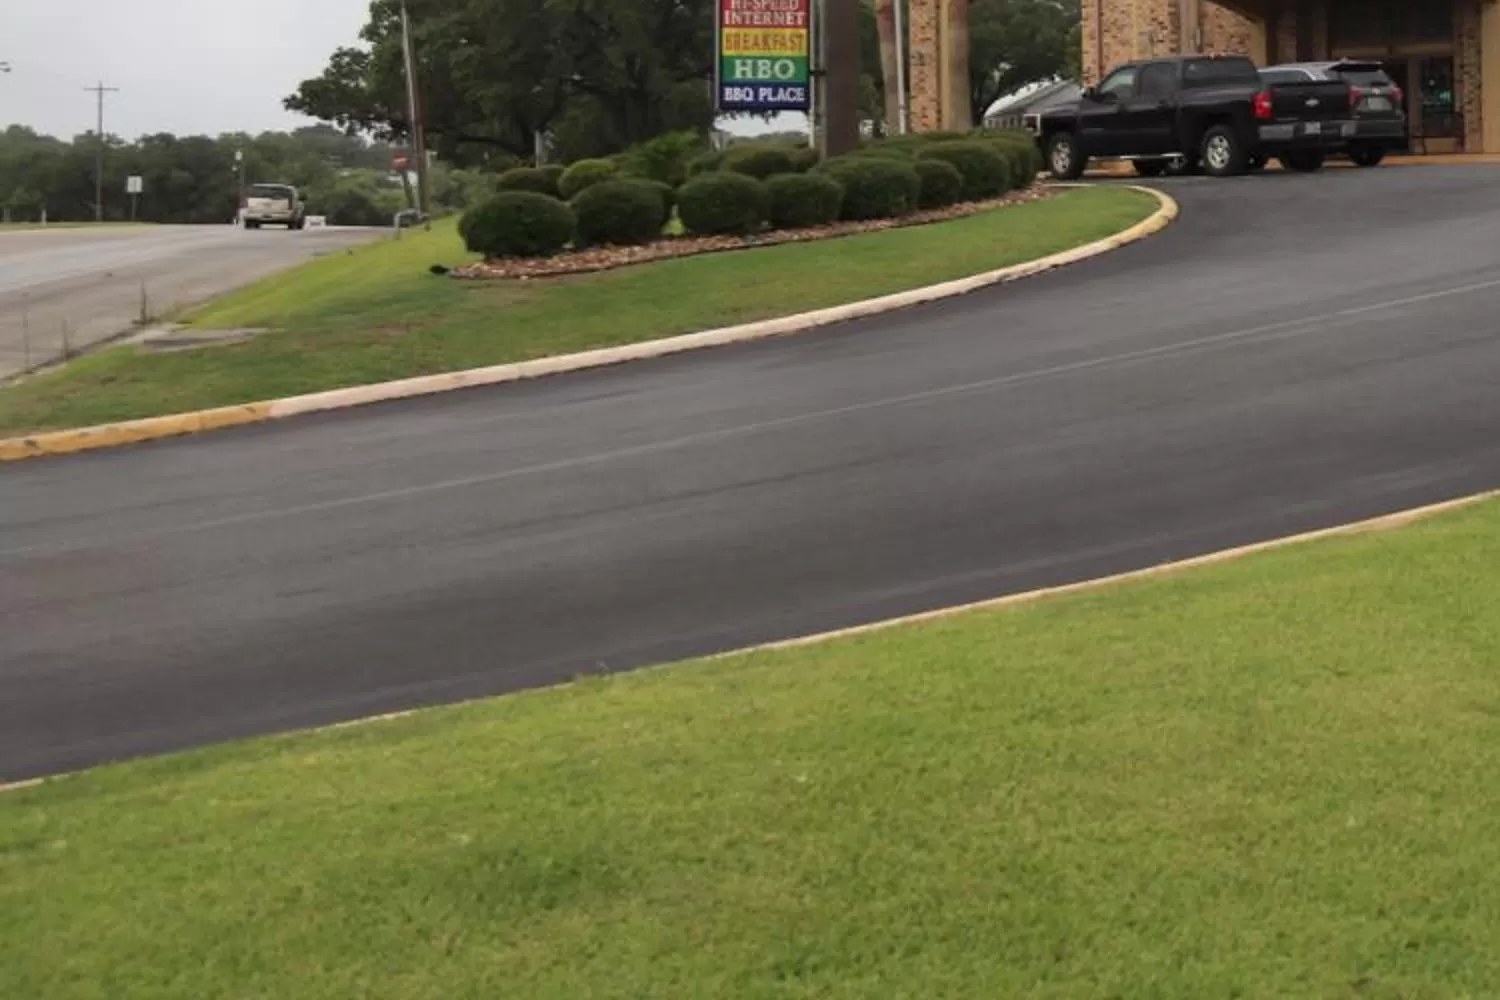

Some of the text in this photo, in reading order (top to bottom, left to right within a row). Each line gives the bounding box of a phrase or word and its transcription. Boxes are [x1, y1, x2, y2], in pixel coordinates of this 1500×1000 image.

[724, 11, 807, 25] INTERNET
[725, 32, 804, 52] BREAKFAST
[734, 59, 796, 80] HBO
[758, 87, 805, 102] PLACE
